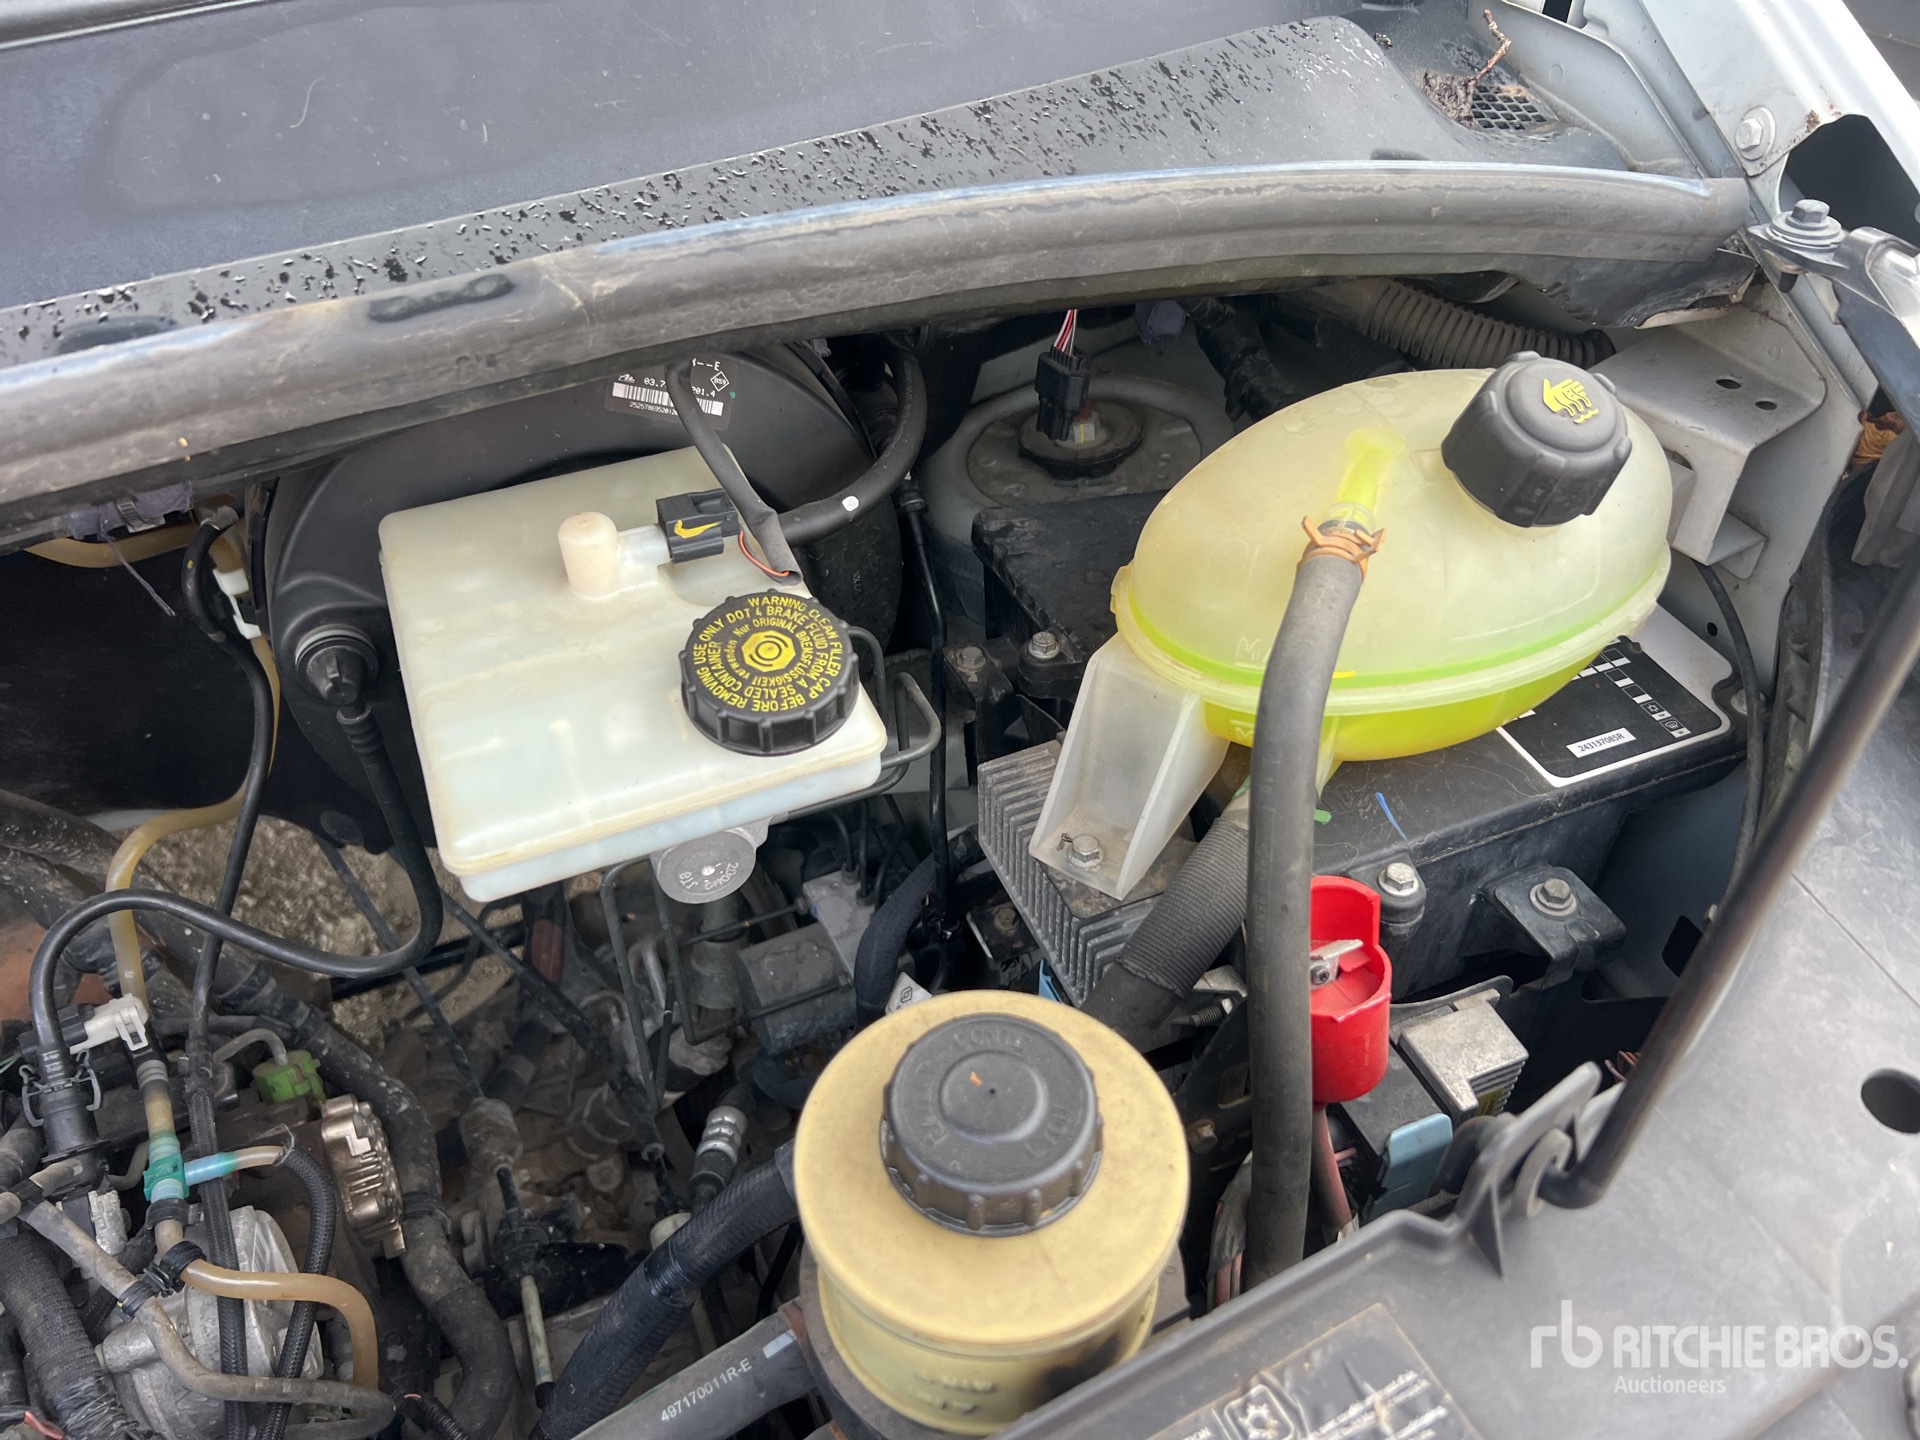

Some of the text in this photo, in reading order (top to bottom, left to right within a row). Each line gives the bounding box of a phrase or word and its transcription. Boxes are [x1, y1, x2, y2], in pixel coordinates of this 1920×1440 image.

[732, 624, 750, 637] Nur
[752, 617, 798, 634] ORIGINAL
[693, 596, 843, 712] WARNING CLEAN FILLER CAP BEFORE REMOVING USE ONLY DOT 4 BRAKE FLUID FROM A SEALED CONTAINER
[724, 639, 750, 680] verwenden
[660, 1357, 752, 1423] 497170011R-E
